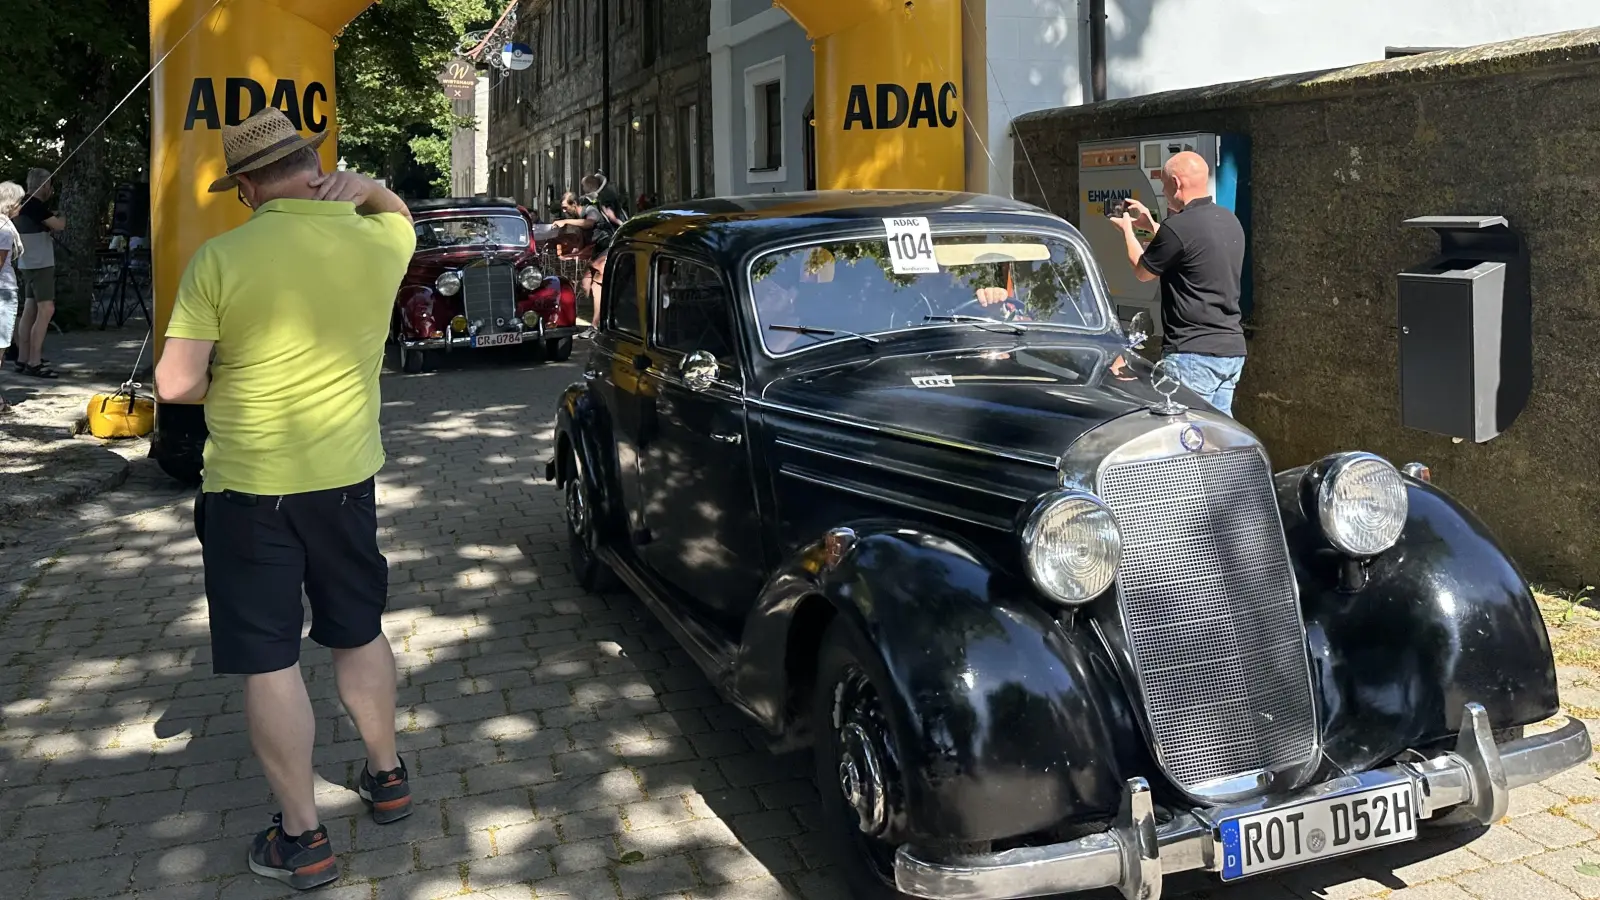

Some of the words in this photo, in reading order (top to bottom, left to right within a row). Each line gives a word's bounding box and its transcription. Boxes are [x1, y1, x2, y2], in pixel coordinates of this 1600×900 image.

[184, 77, 328, 133] ADAC
[843, 81, 958, 130] ADAC
[1088, 189, 1132, 202] EHMANN
[893, 219, 919, 227] ADAC
[889, 233, 932, 260] 104
[477, 336, 490, 346] CR
[1244, 812, 1304, 866] ROT
[1330, 790, 1412, 847] D52H
[1227, 855, 1236, 867] D
